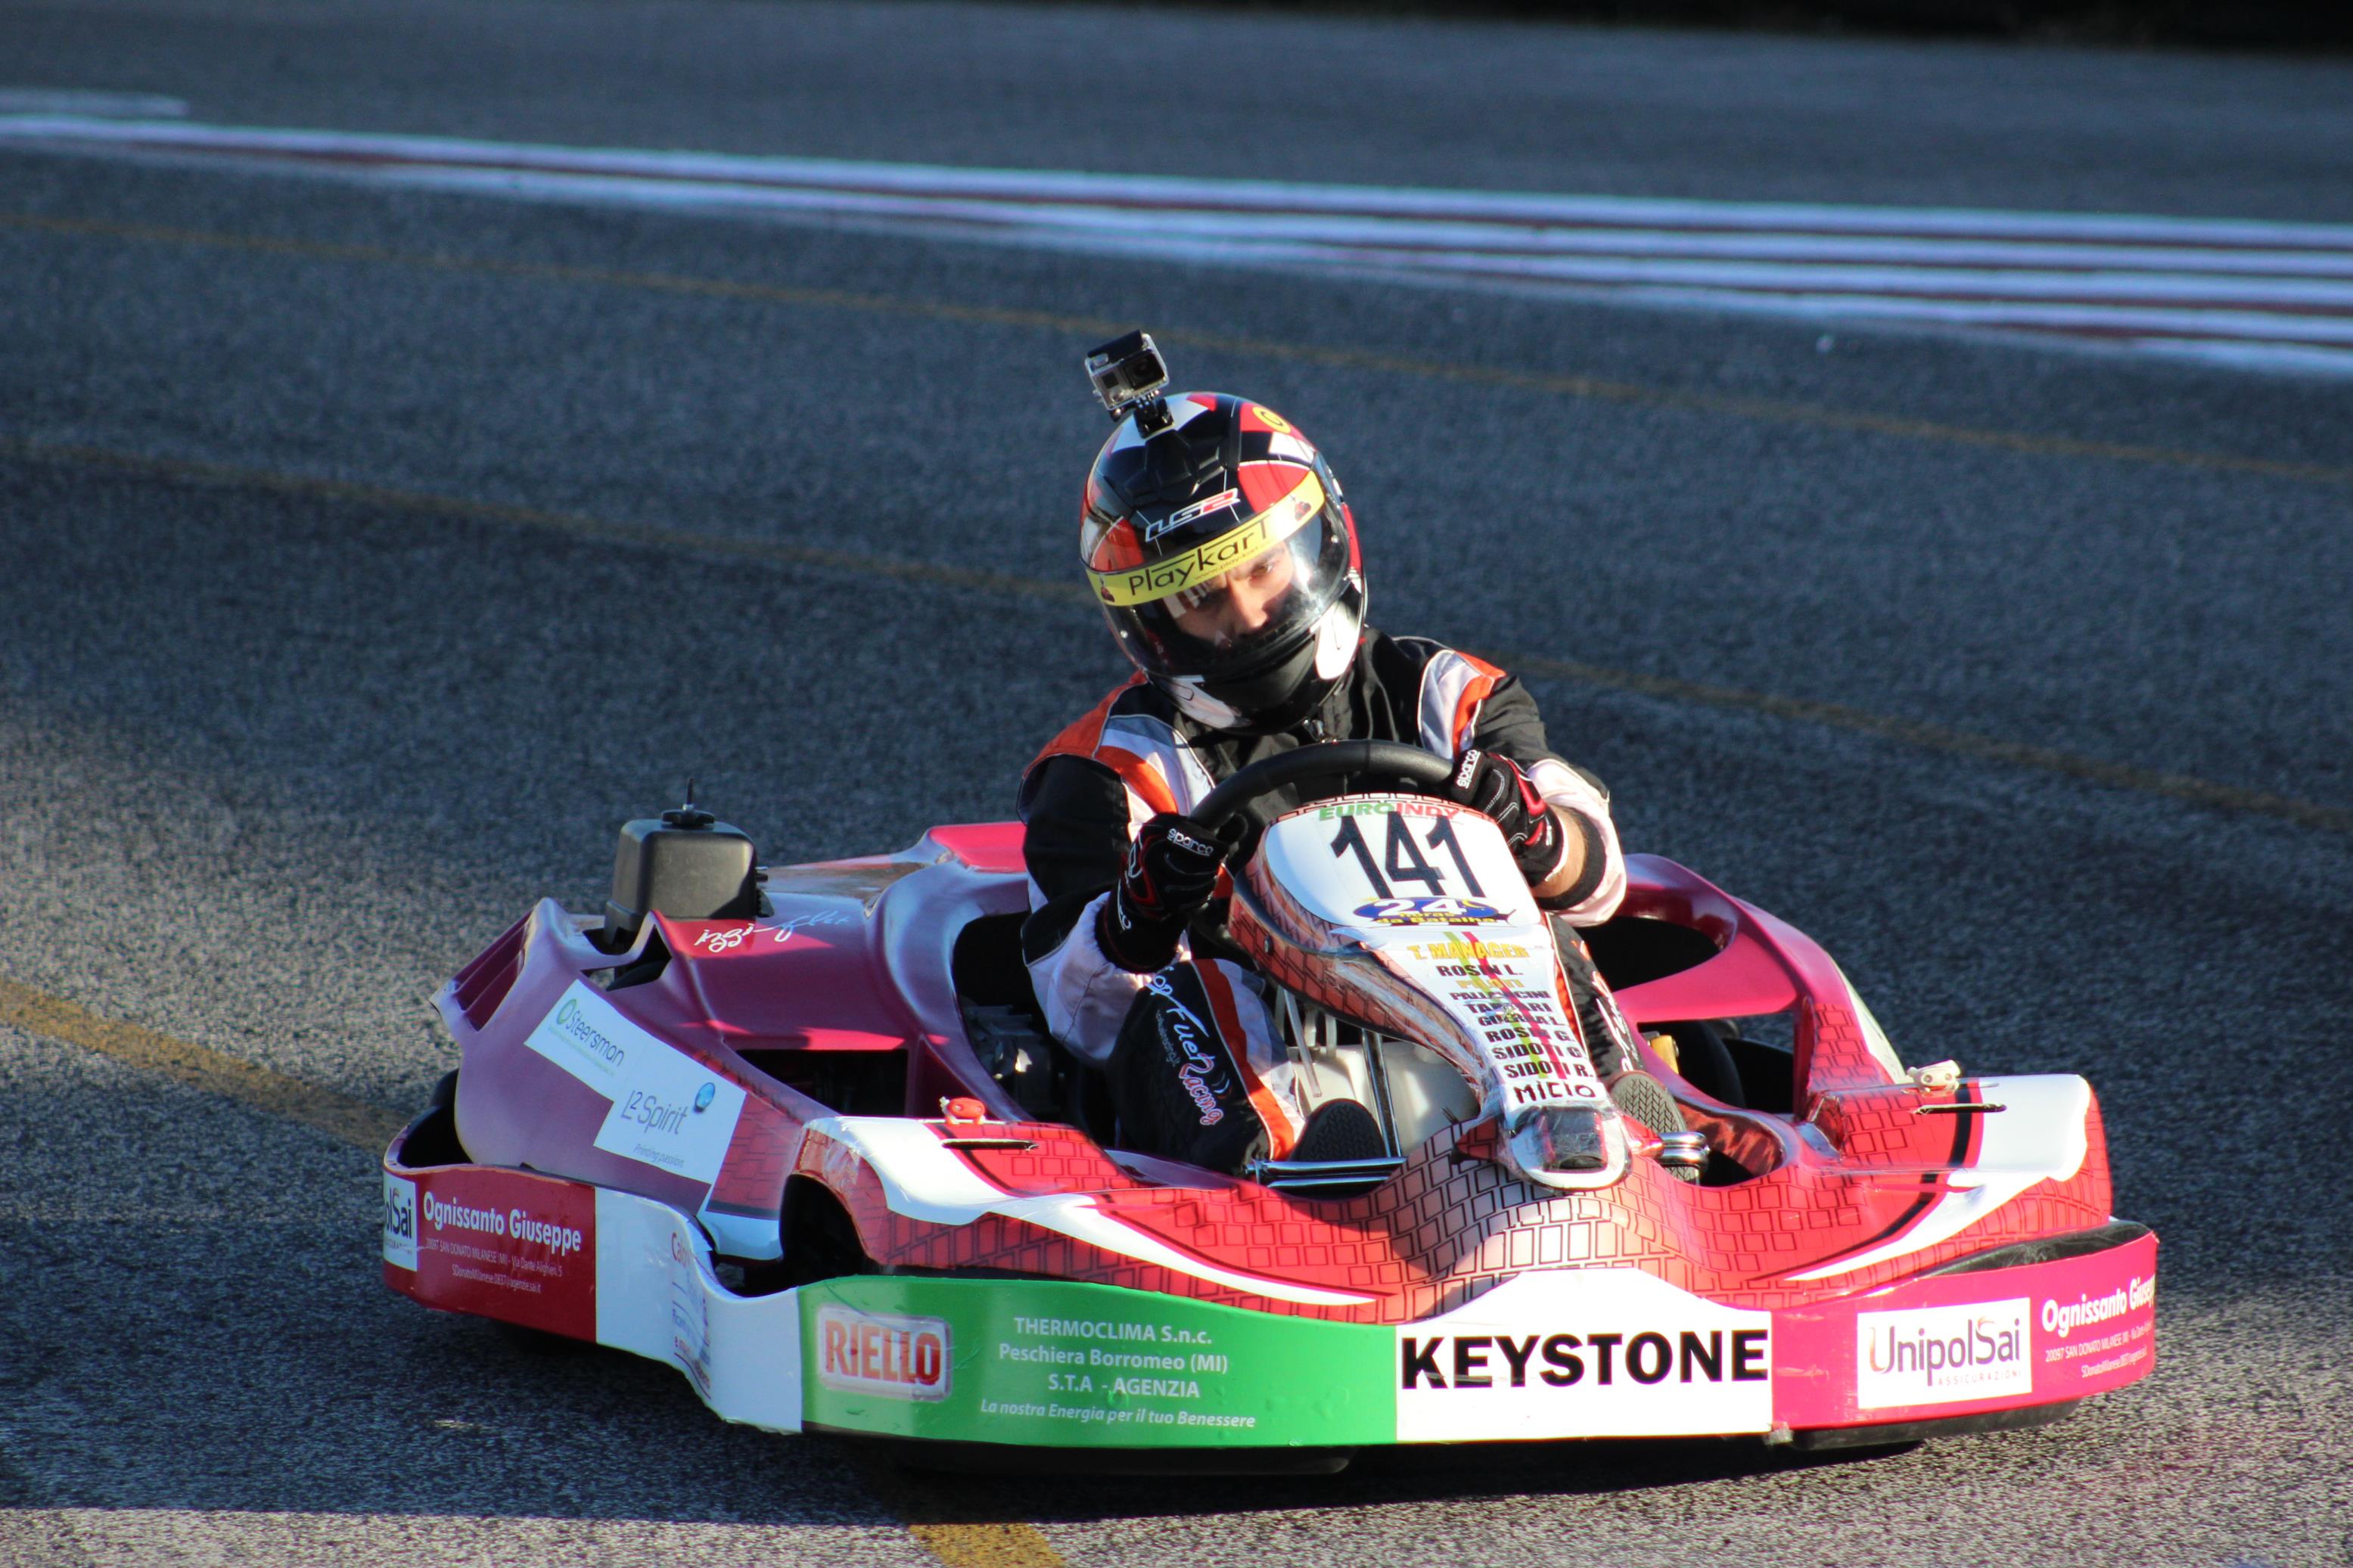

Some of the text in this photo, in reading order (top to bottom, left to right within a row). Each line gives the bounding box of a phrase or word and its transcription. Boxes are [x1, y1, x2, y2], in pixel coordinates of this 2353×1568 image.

[1456, 750, 1481, 789] sparco
[1167, 828, 1214, 856] sparco
[1330, 811, 1487, 899] 141
[1428, 942, 1531, 960] MANAGER
[423, 1191, 582, 1256] Ognissanto Giuseppe
[1014, 1317, 1213, 1344] THERMOCLIMA S.n.c.
[2041, 1287, 2128, 1337] Ognissanto
[825, 1319, 941, 1386] RIELLO
[999, 1343, 1229, 1374] Peschiera Borromeo (MI)
[1401, 1329, 1769, 1389] KEYSTONE
[1869, 1316, 2020, 1386] UnipolSai
[1048, 1374, 1093, 1392] S.T.A
[1113, 1377, 1200, 1398] AGENZIA
[980, 1399, 1256, 1428] La nostra Energia per il tuo Benessere
